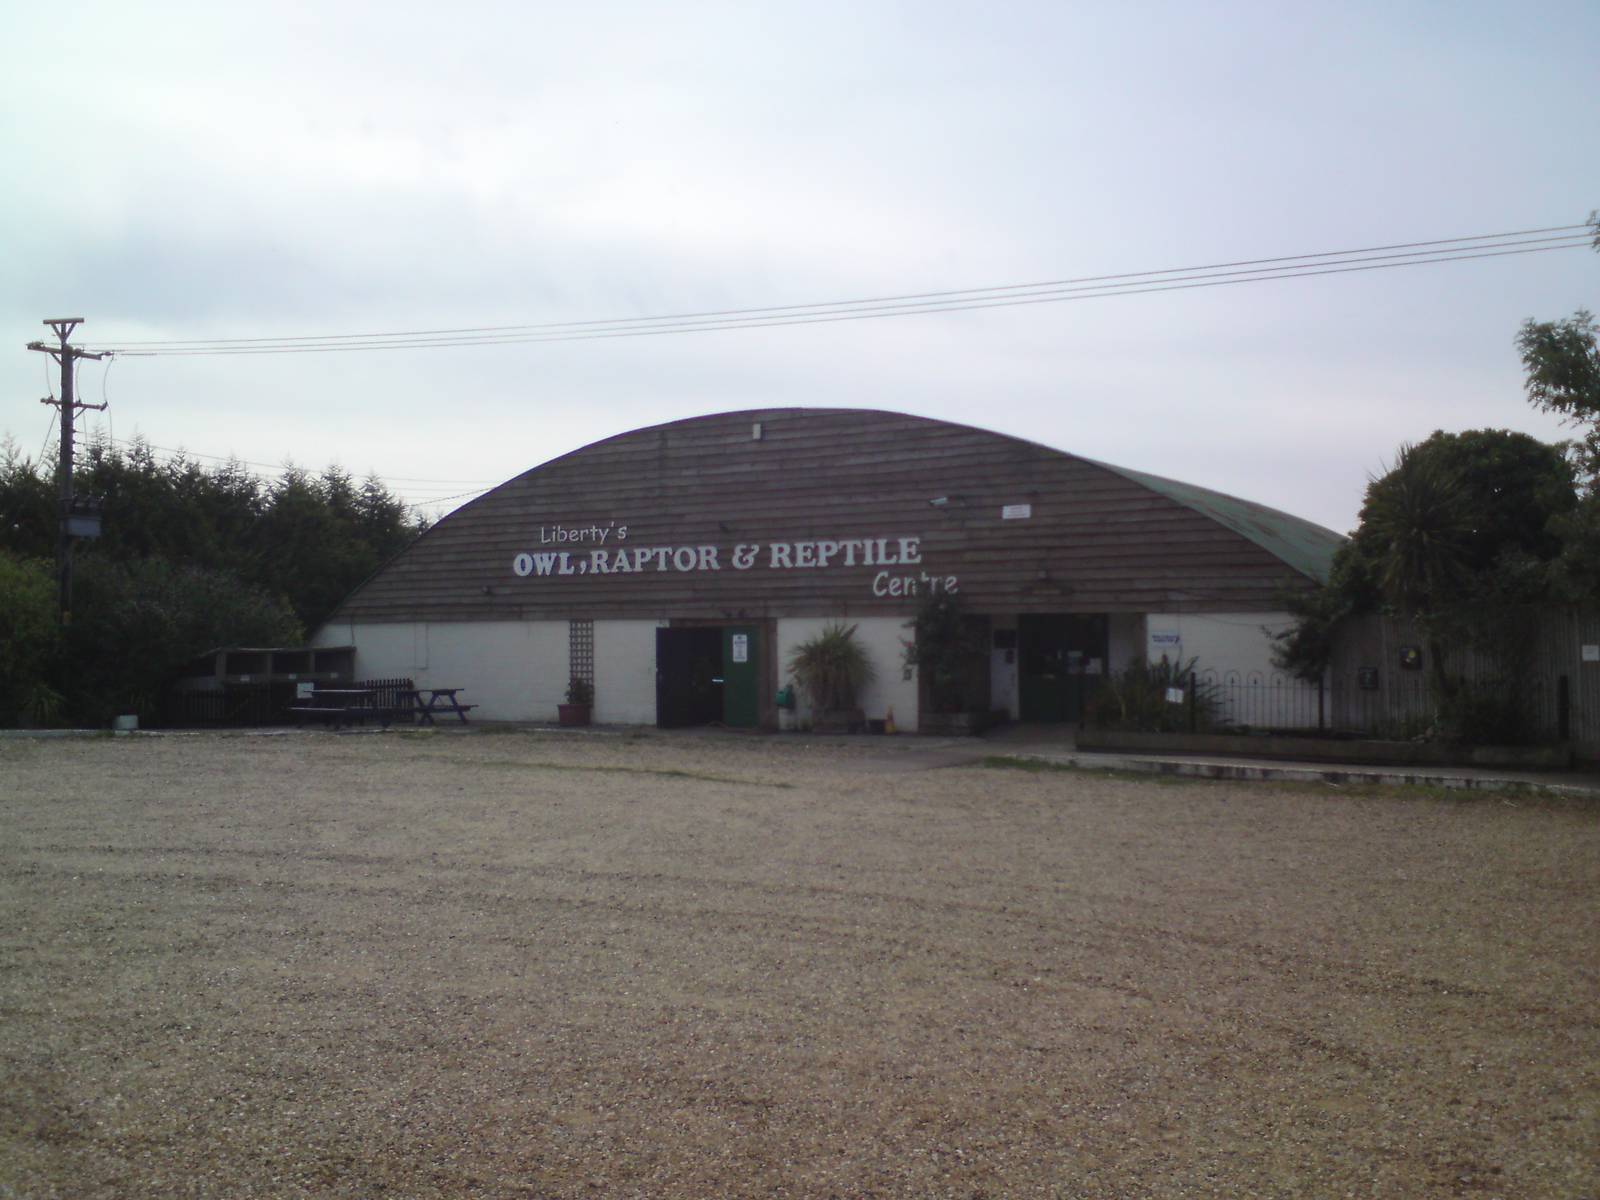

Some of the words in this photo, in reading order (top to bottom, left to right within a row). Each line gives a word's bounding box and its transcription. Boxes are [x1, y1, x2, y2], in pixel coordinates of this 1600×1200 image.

[540, 521, 628, 545] Liberty's
[731, 543, 760, 570] &
[769, 537, 922, 568] REPTILE
